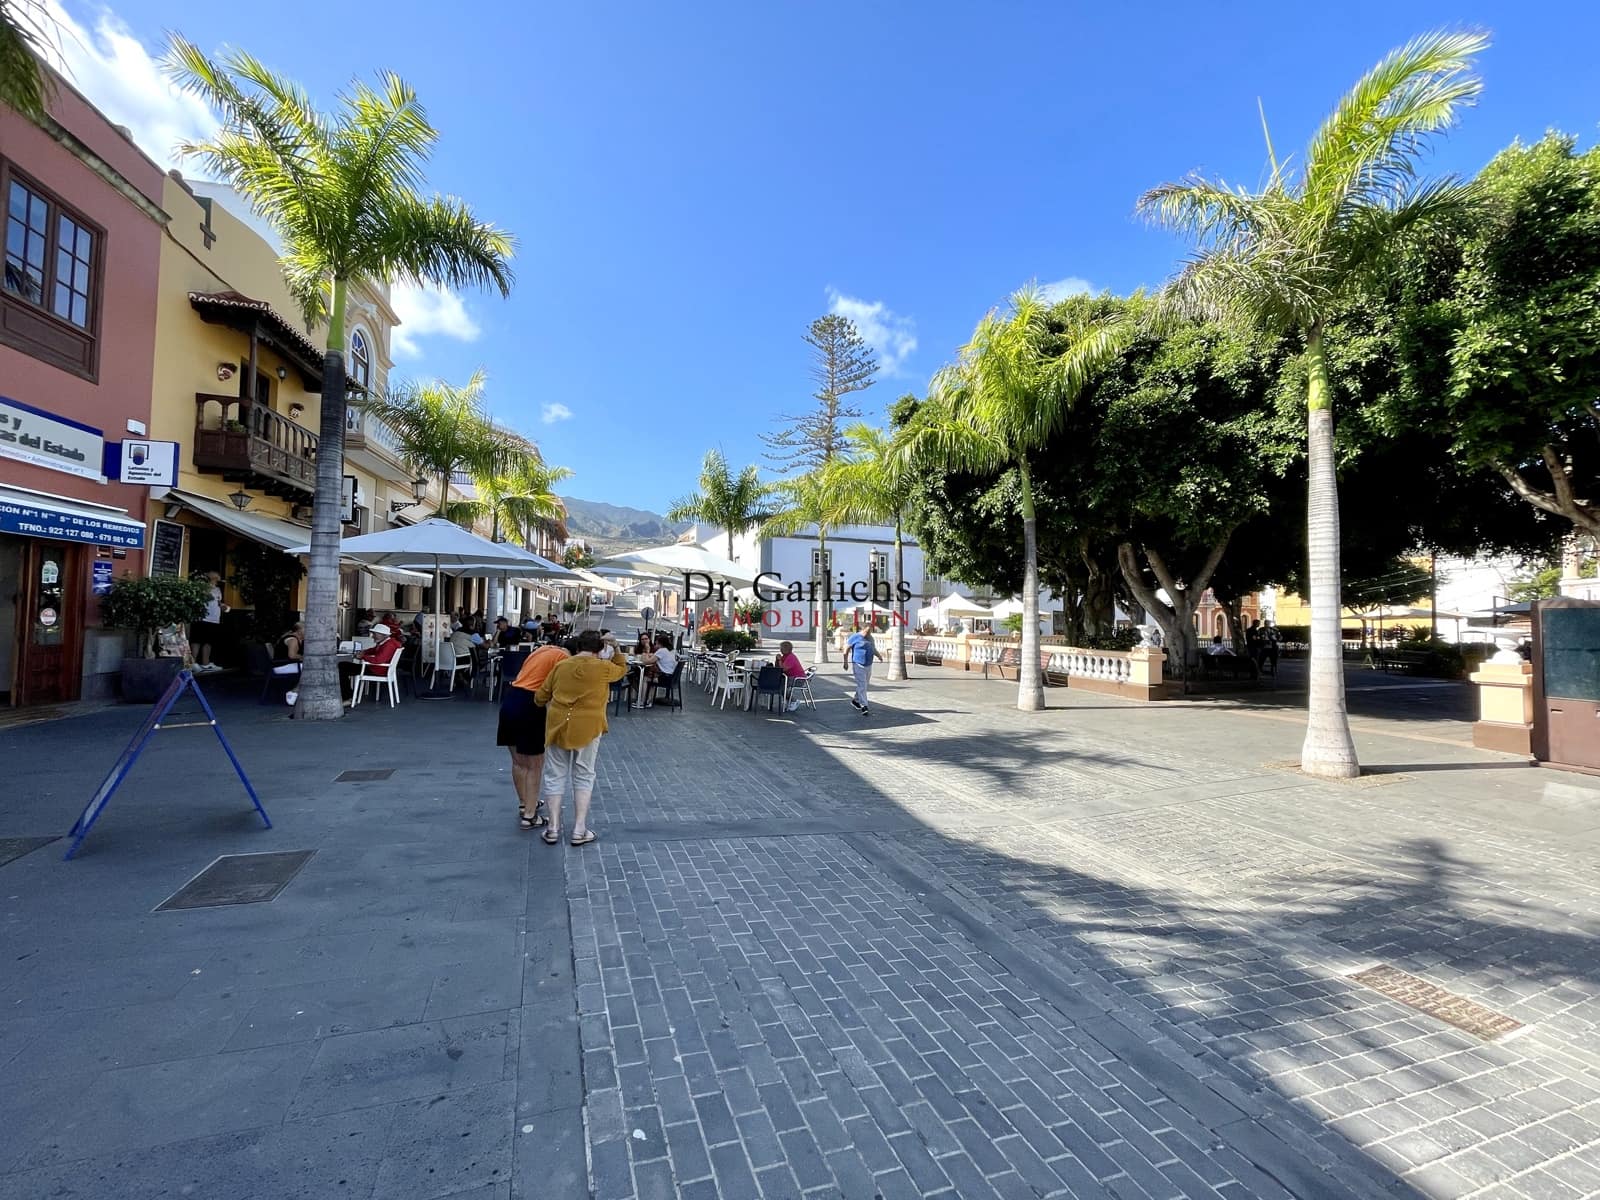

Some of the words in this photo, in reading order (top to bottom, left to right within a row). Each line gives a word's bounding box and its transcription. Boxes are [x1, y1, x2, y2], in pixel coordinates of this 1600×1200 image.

[12, 417, 22, 431] y
[19, 433, 40, 449] del
[43, 440, 85, 462] Estado
[65, 529, 79, 537] 127
[72, 518, 84, 526] DE
[85, 520, 101, 528] LOS
[102, 523, 140, 534] REMEDIOS
